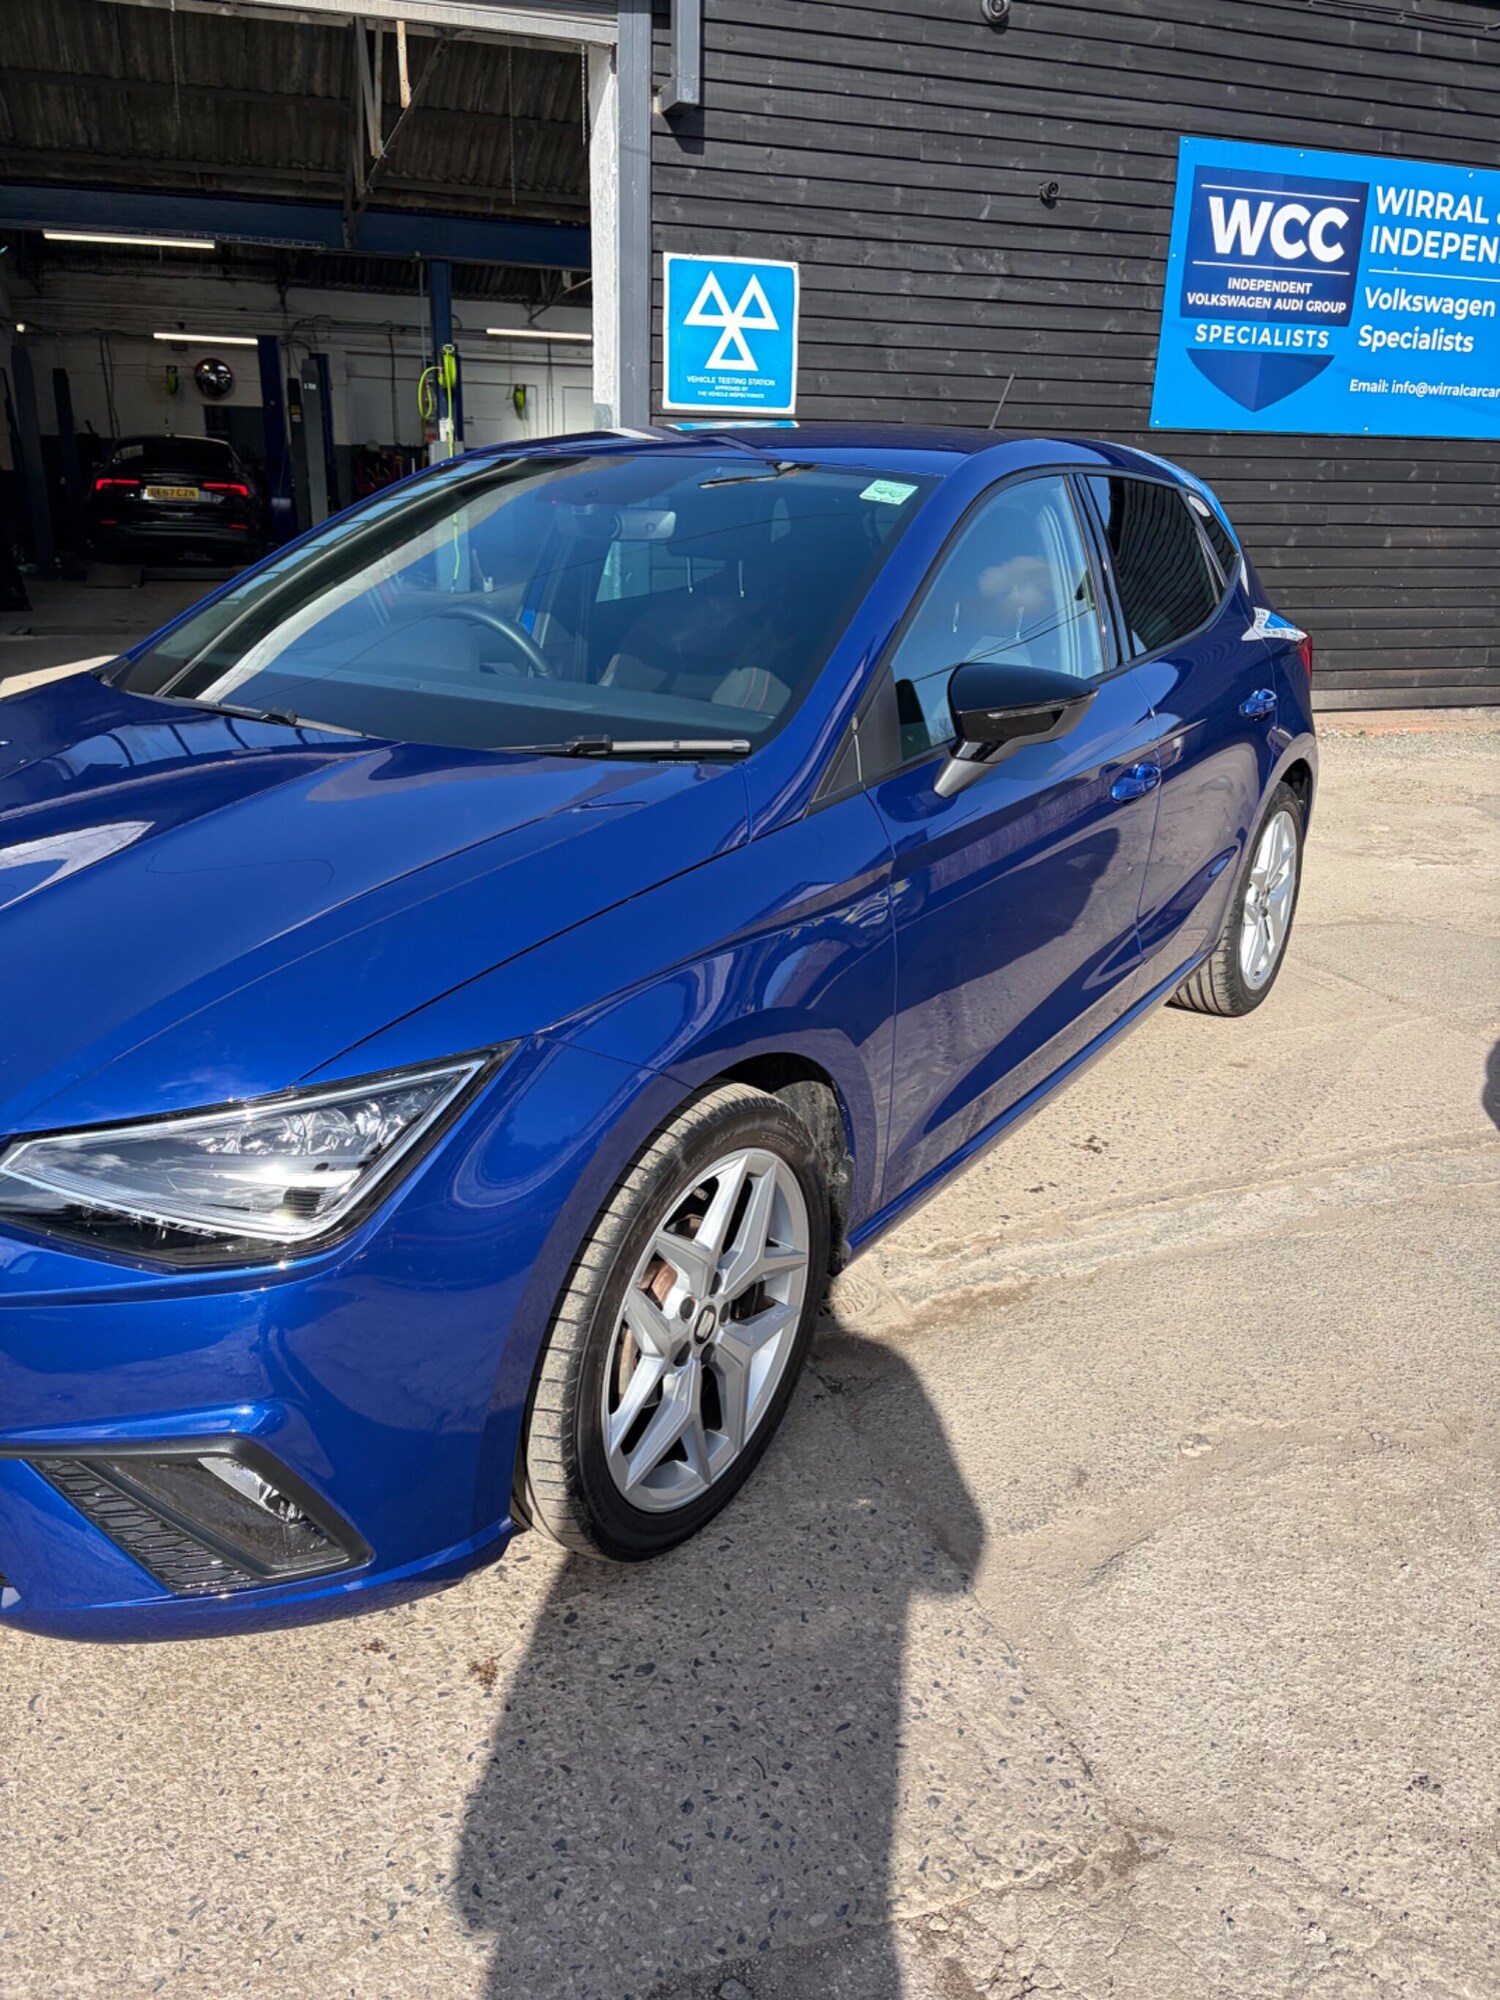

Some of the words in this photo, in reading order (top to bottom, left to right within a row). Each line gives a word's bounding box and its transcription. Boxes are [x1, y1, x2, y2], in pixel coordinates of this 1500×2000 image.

[1375, 185, 1490, 225] WIRRAL
[1208, 195, 1350, 263] WCC
[1369, 225, 1500, 265] INDEPEN
[1227, 276, 1313, 295] INDEPENDENT
[1187, 292, 1272, 310] VOLKSWAGEN
[1273, 298, 1304, 312] AUDI
[1305, 300, 1347, 314] GROUP
[1364, 286, 1496, 321] Volkswagen
[1194, 323, 1330, 349] SPECIALISTS
[1358, 324, 1475, 353] Specialists
[686, 375, 716, 384] VEHICLE
[718, 376, 747, 385] TESTING
[748, 378, 776, 387] STATION
[1349, 378, 1389, 393] Email:
